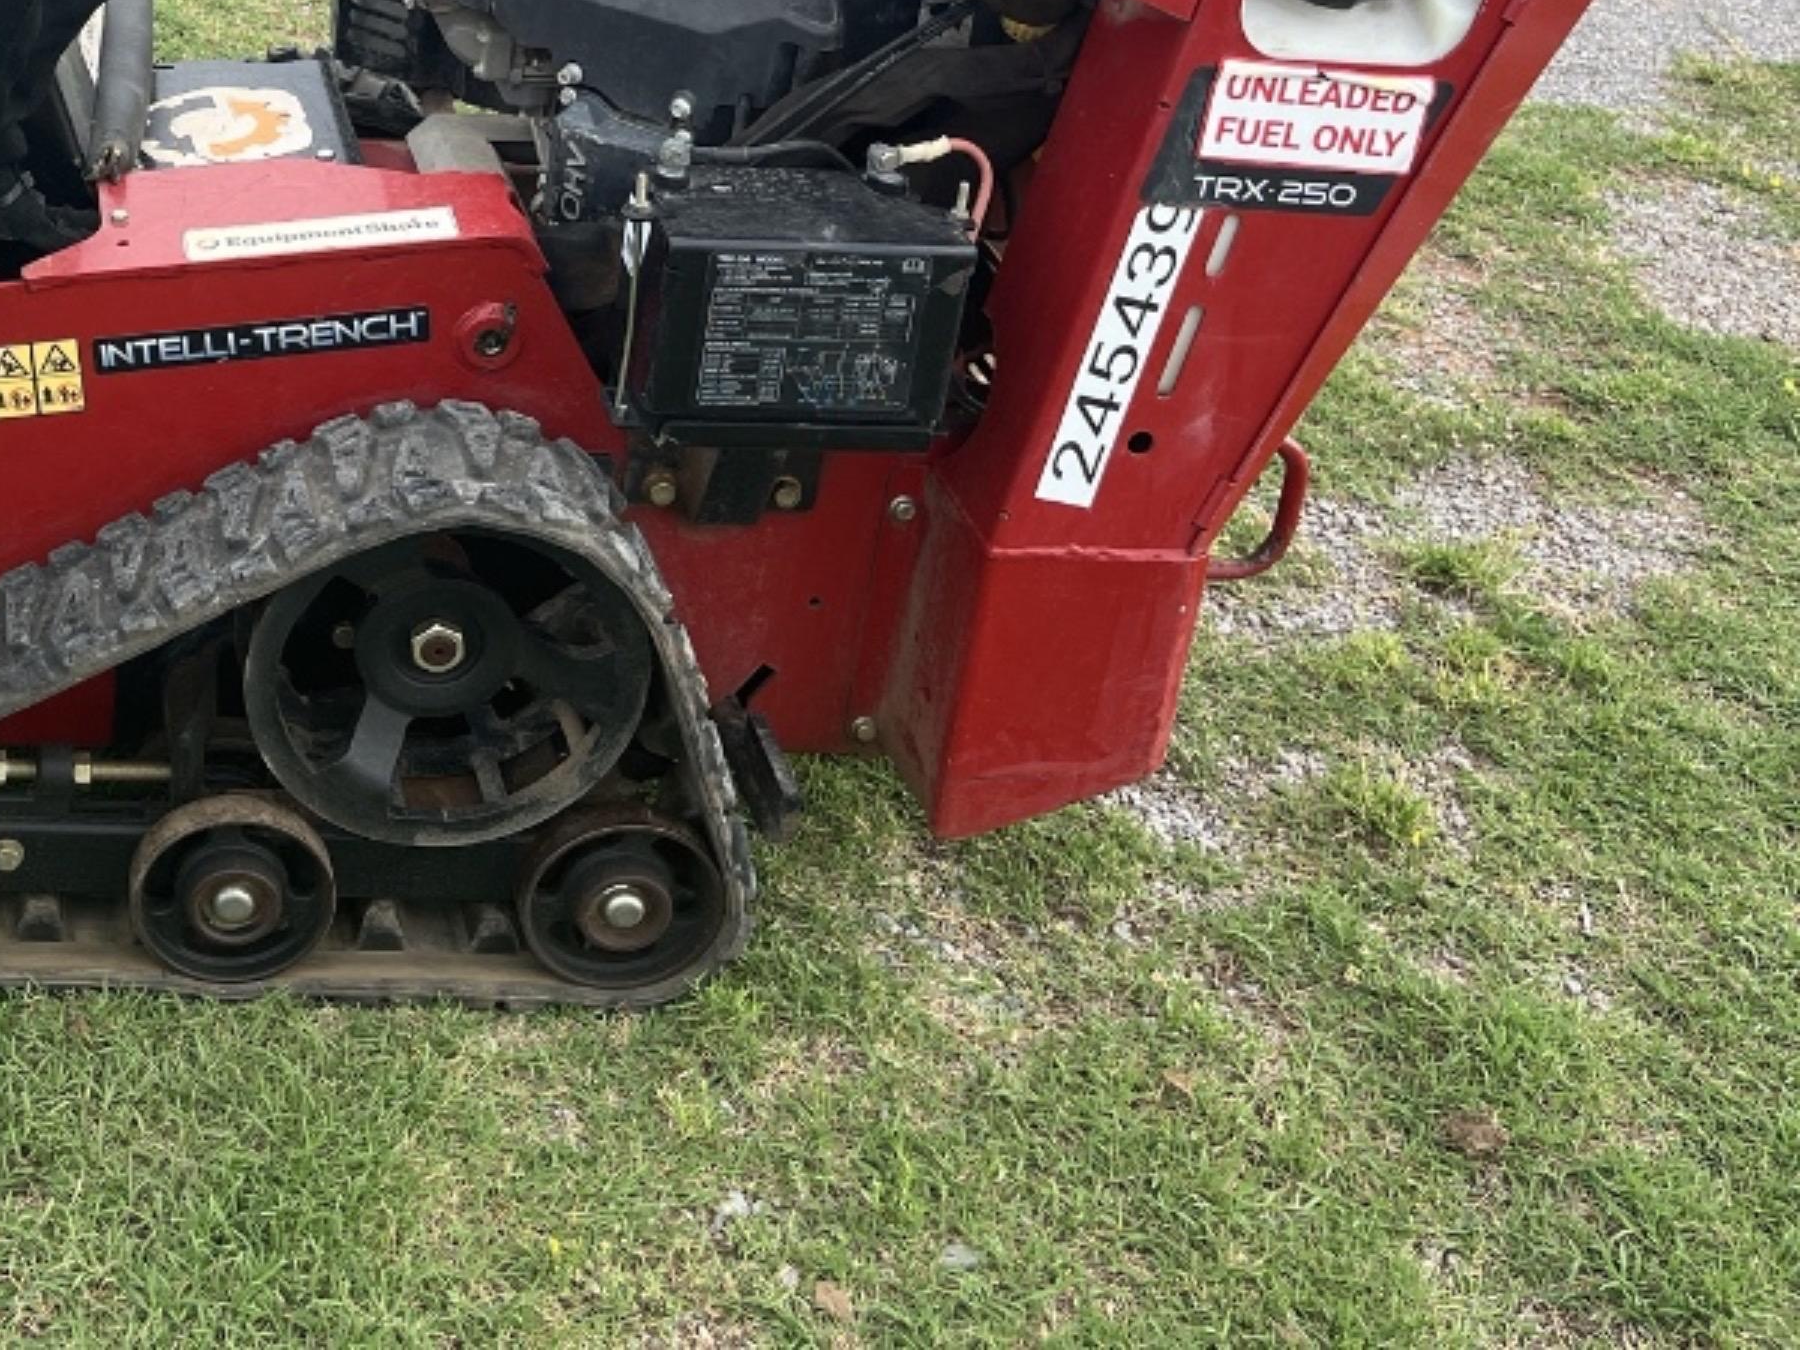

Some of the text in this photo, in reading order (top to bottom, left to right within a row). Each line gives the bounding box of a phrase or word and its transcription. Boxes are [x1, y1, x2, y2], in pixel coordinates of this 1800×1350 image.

[1226, 73, 1418, 113] UNLEADED
[1214, 116, 1407, 157] FUEL ONLY
